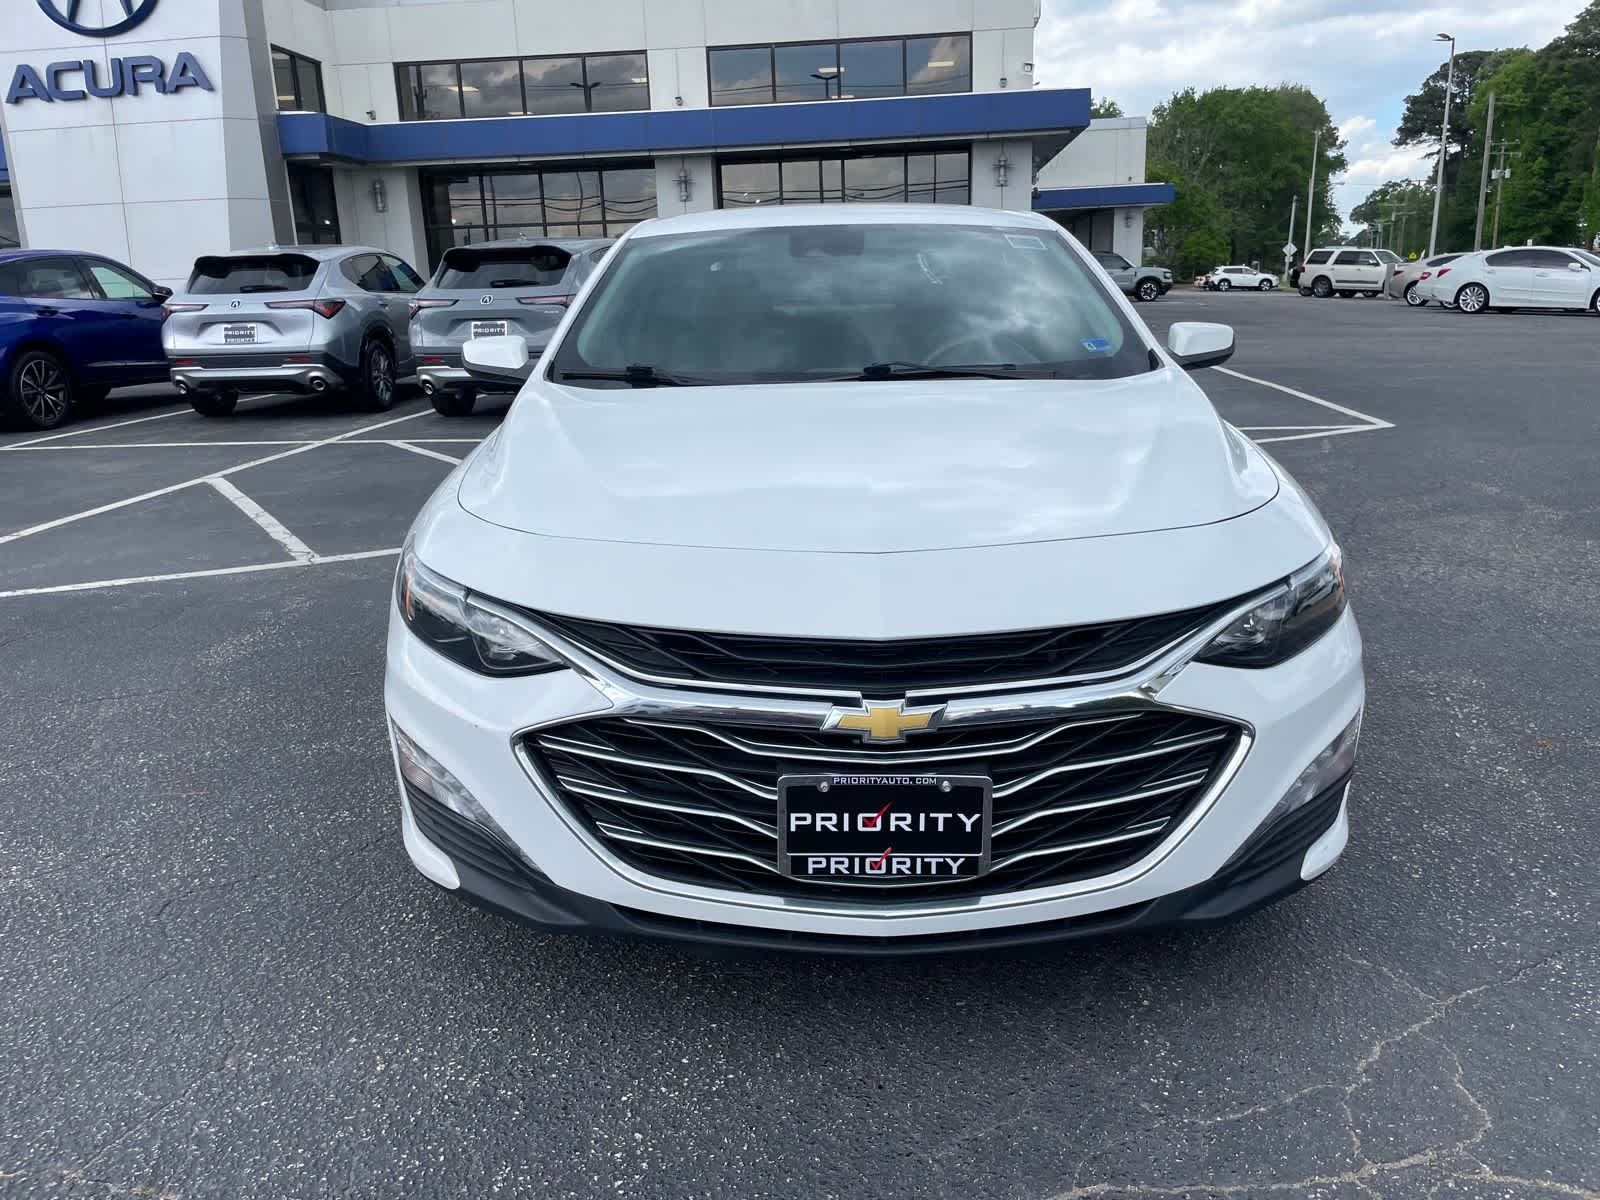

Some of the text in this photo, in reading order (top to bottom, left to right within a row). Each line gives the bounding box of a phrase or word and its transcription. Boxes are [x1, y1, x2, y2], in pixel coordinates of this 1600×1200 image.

[6, 52, 214, 104] ACURA
[790, 812, 981, 832] PRIORITY
[807, 856, 966, 875] PRIORITY
